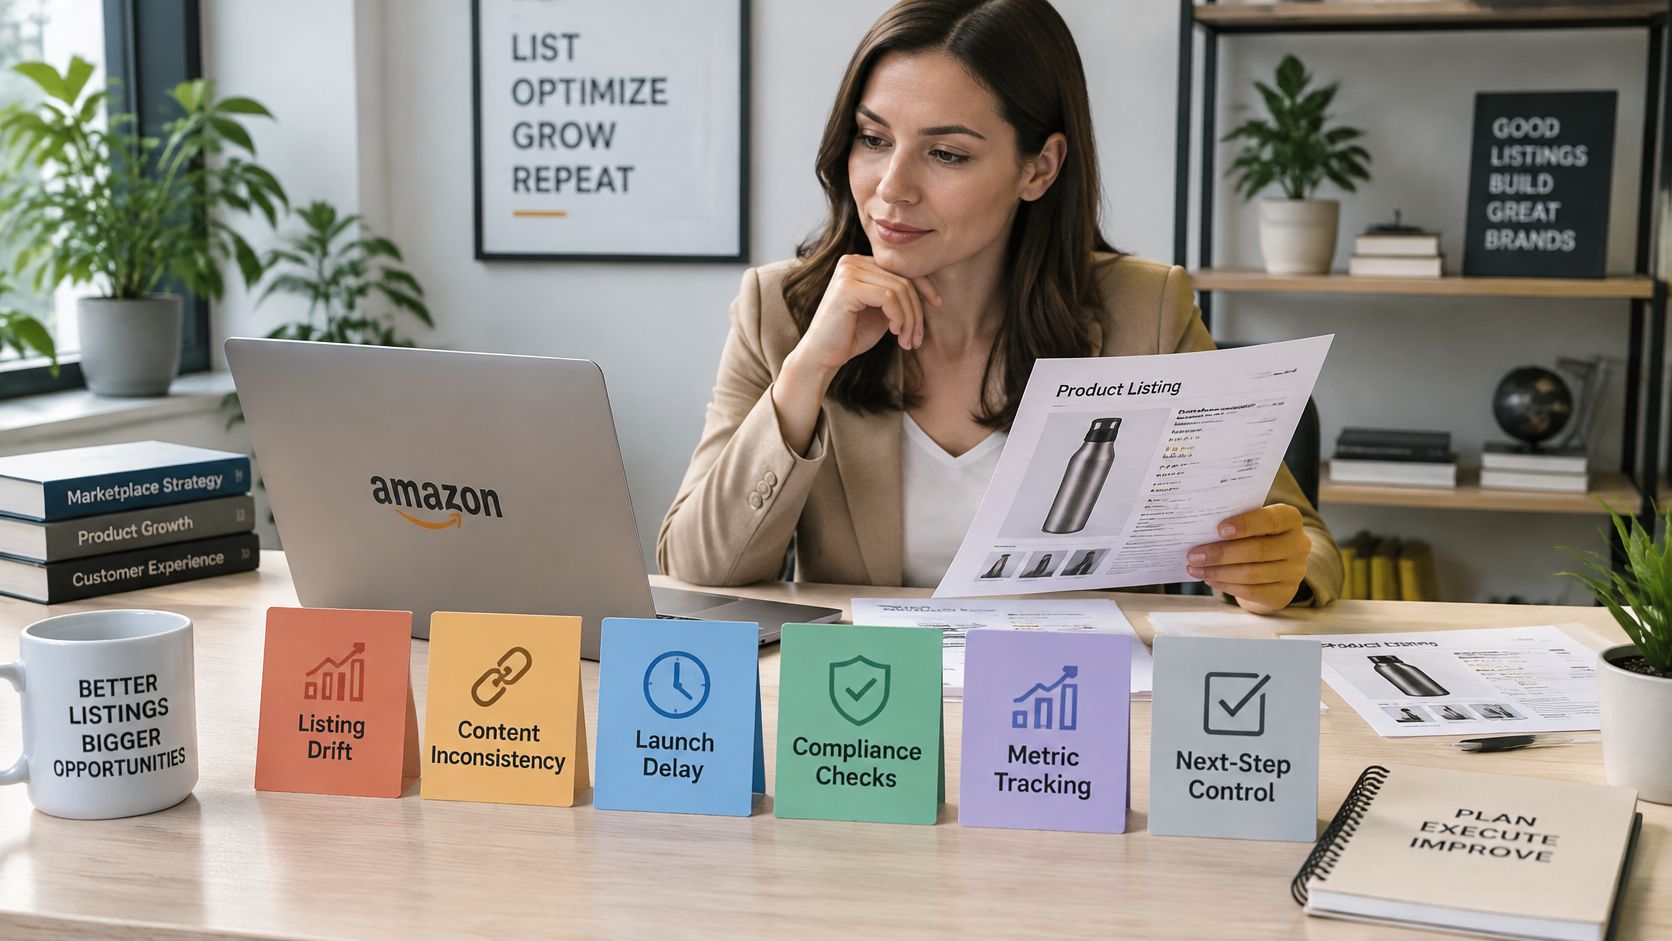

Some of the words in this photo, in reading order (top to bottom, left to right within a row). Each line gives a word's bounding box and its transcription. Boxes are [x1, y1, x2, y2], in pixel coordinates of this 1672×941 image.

[512, 32, 580, 62] LIST
[511, 77, 669, 106] OPTIMIZE
[512, 122, 616, 150] GROW
[1492, 117, 1561, 139] GOOD
[1490, 145, 1589, 167] LISTINGS
[512, 165, 635, 193] REPEAT
[1488, 173, 1555, 195] BUILD
[1486, 200, 1562, 223] GREAT
[1484, 228, 1577, 251] BRANDS
[1056, 382, 1124, 398] Product
[1127, 380, 1182, 396] Listing
[67, 482, 159, 506] Marketplace
[163, 473, 223, 493] Strategy
[370, 475, 503, 518] amazon
[78, 523, 138, 546] Product
[141, 516, 194, 537] Growth
[72, 563, 145, 587] Customer
[148, 552, 224, 576] Experience
[78, 673, 158, 698] BETTER
[69, 697, 169, 725] LISTINGS
[298, 714, 365, 739] Listing
[458, 720, 540, 742] Content
[82, 728, 161, 753] BIGGER
[308, 740, 353, 761] Drift
[636, 729, 714, 753] Launch
[792, 737, 922, 763] Compliance
[54, 747, 185, 778] OPPORTUNITIES
[431, 745, 566, 775] Inconsistency
[1007, 744, 1080, 767] Metric
[1176, 750, 1291, 778] Next-Step
[643, 757, 704, 784] Delay
[816, 766, 897, 788] Checks
[994, 772, 1092, 800] Tracking
[1188, 779, 1275, 802] Control
[1454, 808, 1537, 827] PLAN
[1419, 821, 1560, 846] EXECUTE
[1409, 837, 1554, 863] IMPROVE
